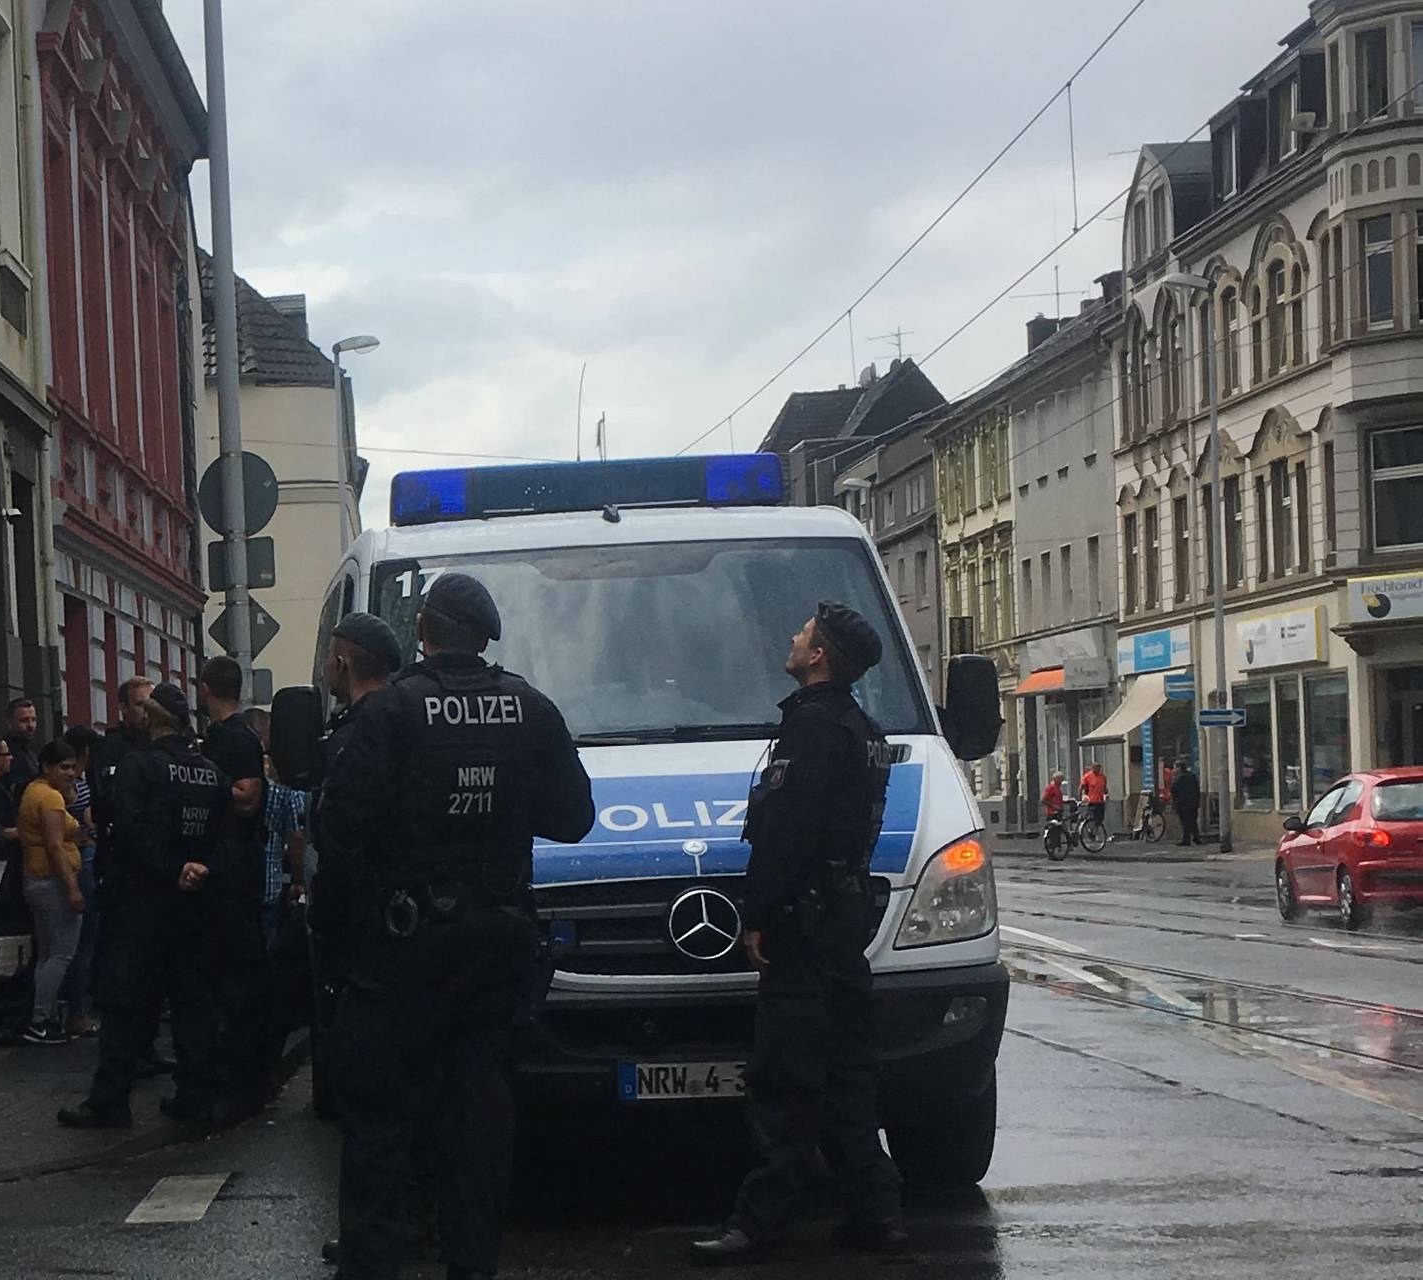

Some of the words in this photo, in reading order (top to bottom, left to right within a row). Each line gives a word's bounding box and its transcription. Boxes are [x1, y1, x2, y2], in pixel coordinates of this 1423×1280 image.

[395, 567, 446, 597] 17
[424, 695, 524, 725] POLIZEI
[168, 764, 218, 786] POLIZEI
[457, 766, 496, 787] NRW
[181, 807, 209, 821] NRW
[448, 792, 492, 814] 2711
[637, 1066, 687, 1095] NRW
